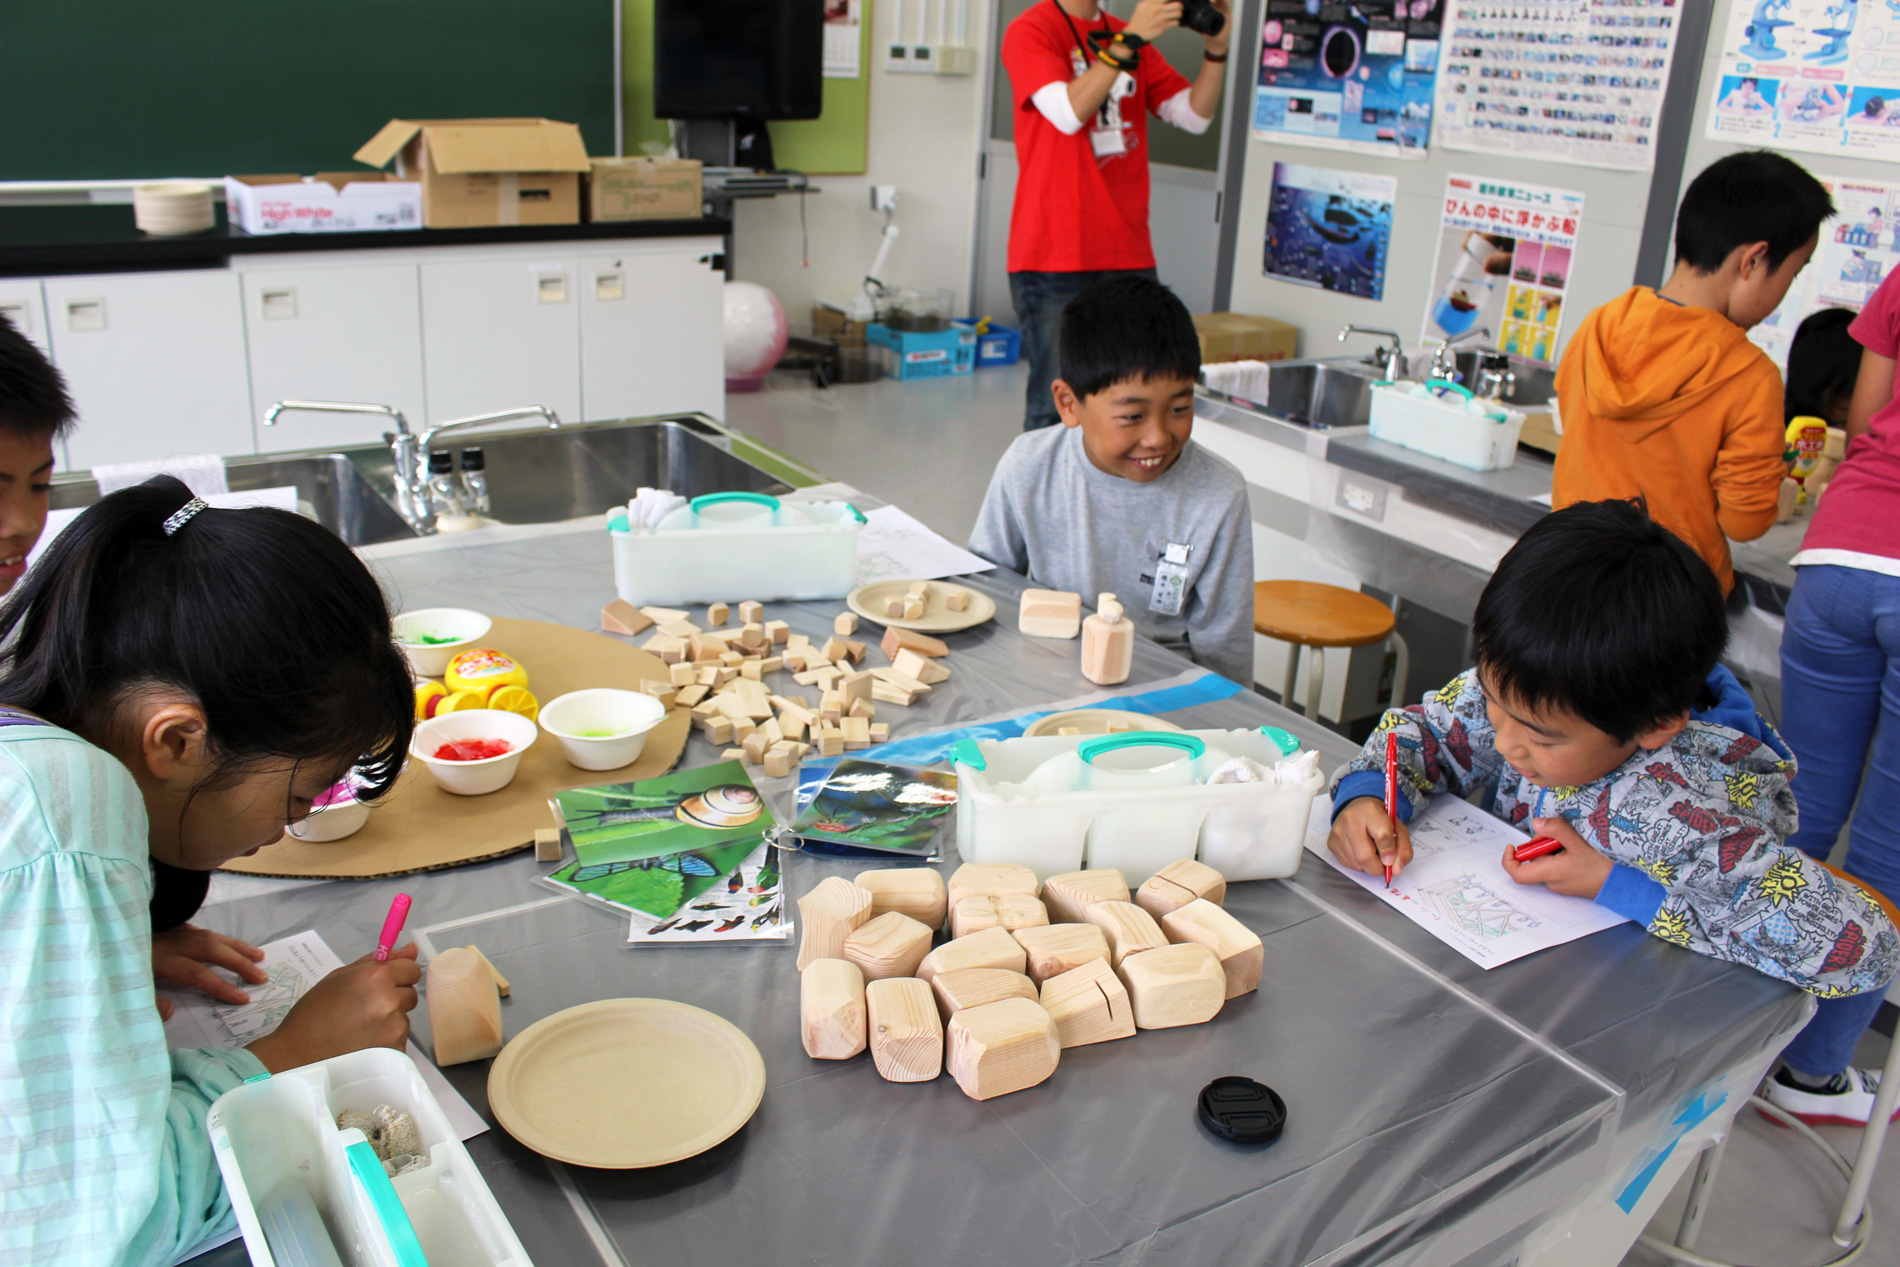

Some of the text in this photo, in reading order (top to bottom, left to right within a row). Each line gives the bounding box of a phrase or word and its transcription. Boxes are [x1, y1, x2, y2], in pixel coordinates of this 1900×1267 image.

[1445, 199, 1578, 236] びんの中に浮かぶ船
[1803, 892, 1839, 916] WITH GREAT
[1819, 910, 1838, 924] COMES
